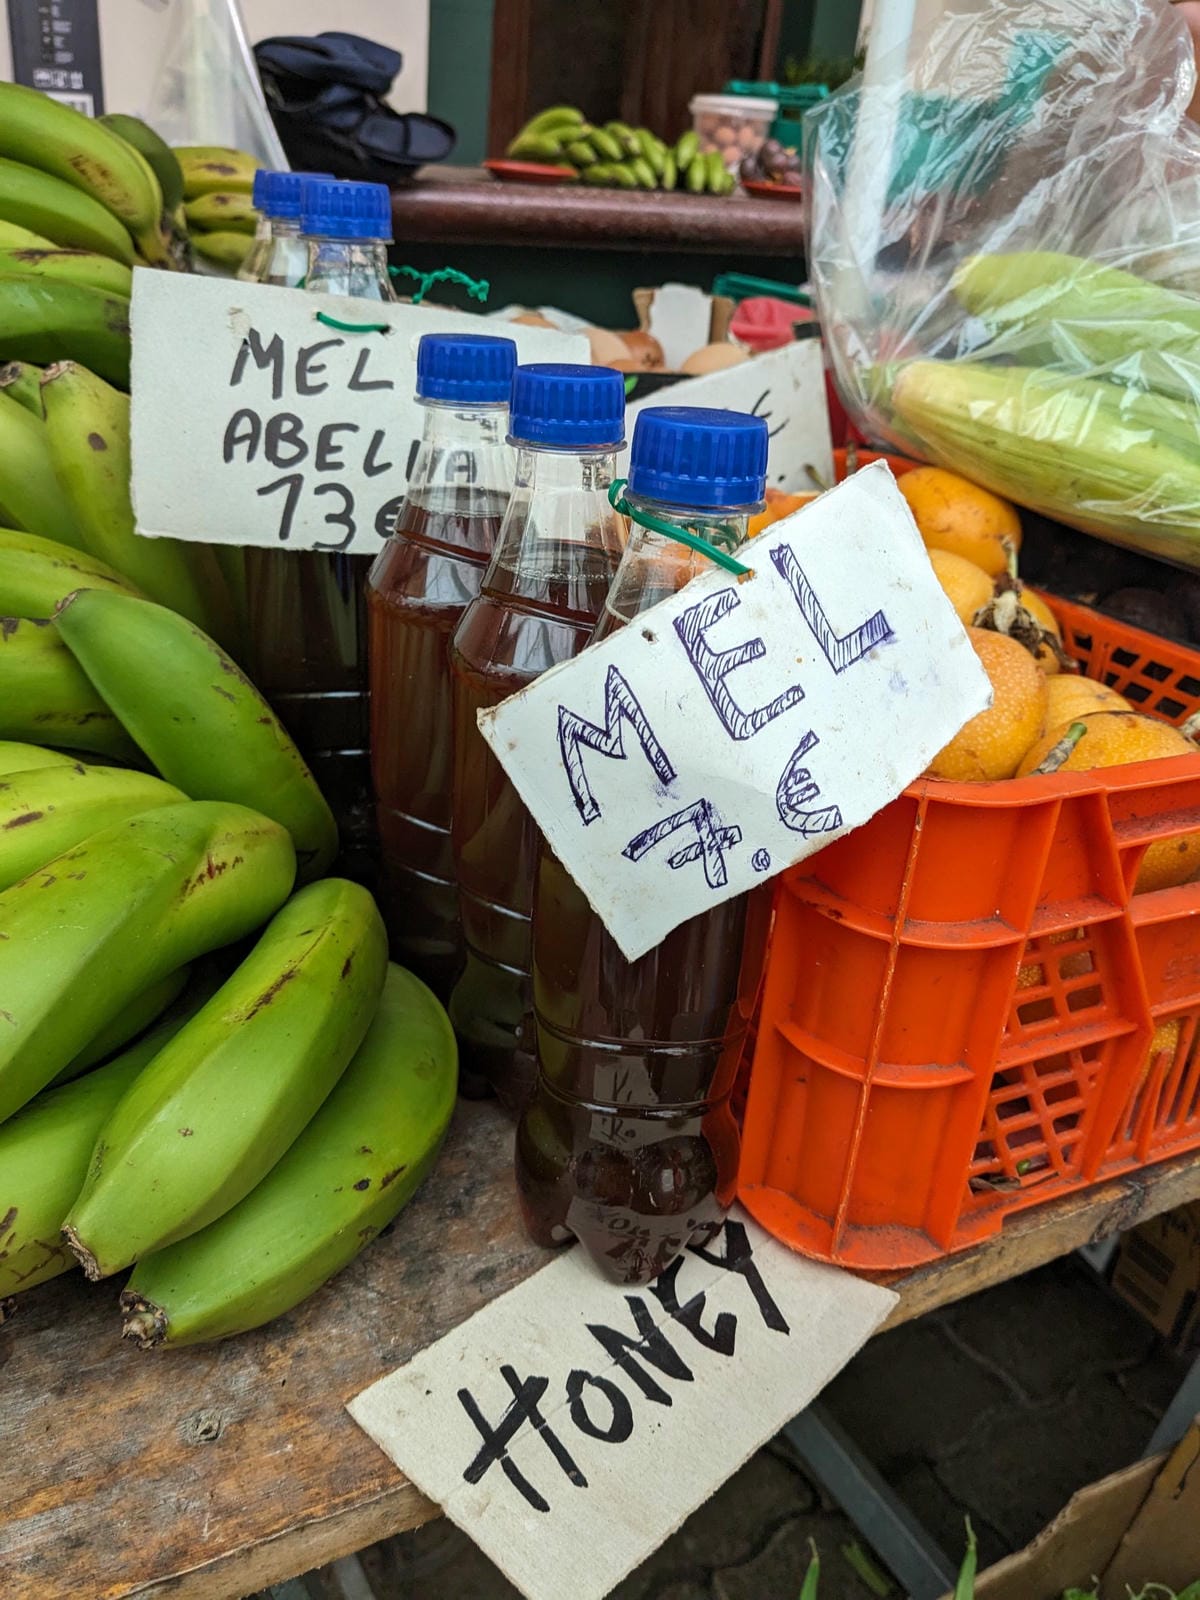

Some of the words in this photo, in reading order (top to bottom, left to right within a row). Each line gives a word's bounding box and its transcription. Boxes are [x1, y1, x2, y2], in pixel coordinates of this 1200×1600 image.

[230, 327, 394, 400] MEL
[557, 543, 893, 825] MEL
[457, 1217, 790, 1513] HONEY
